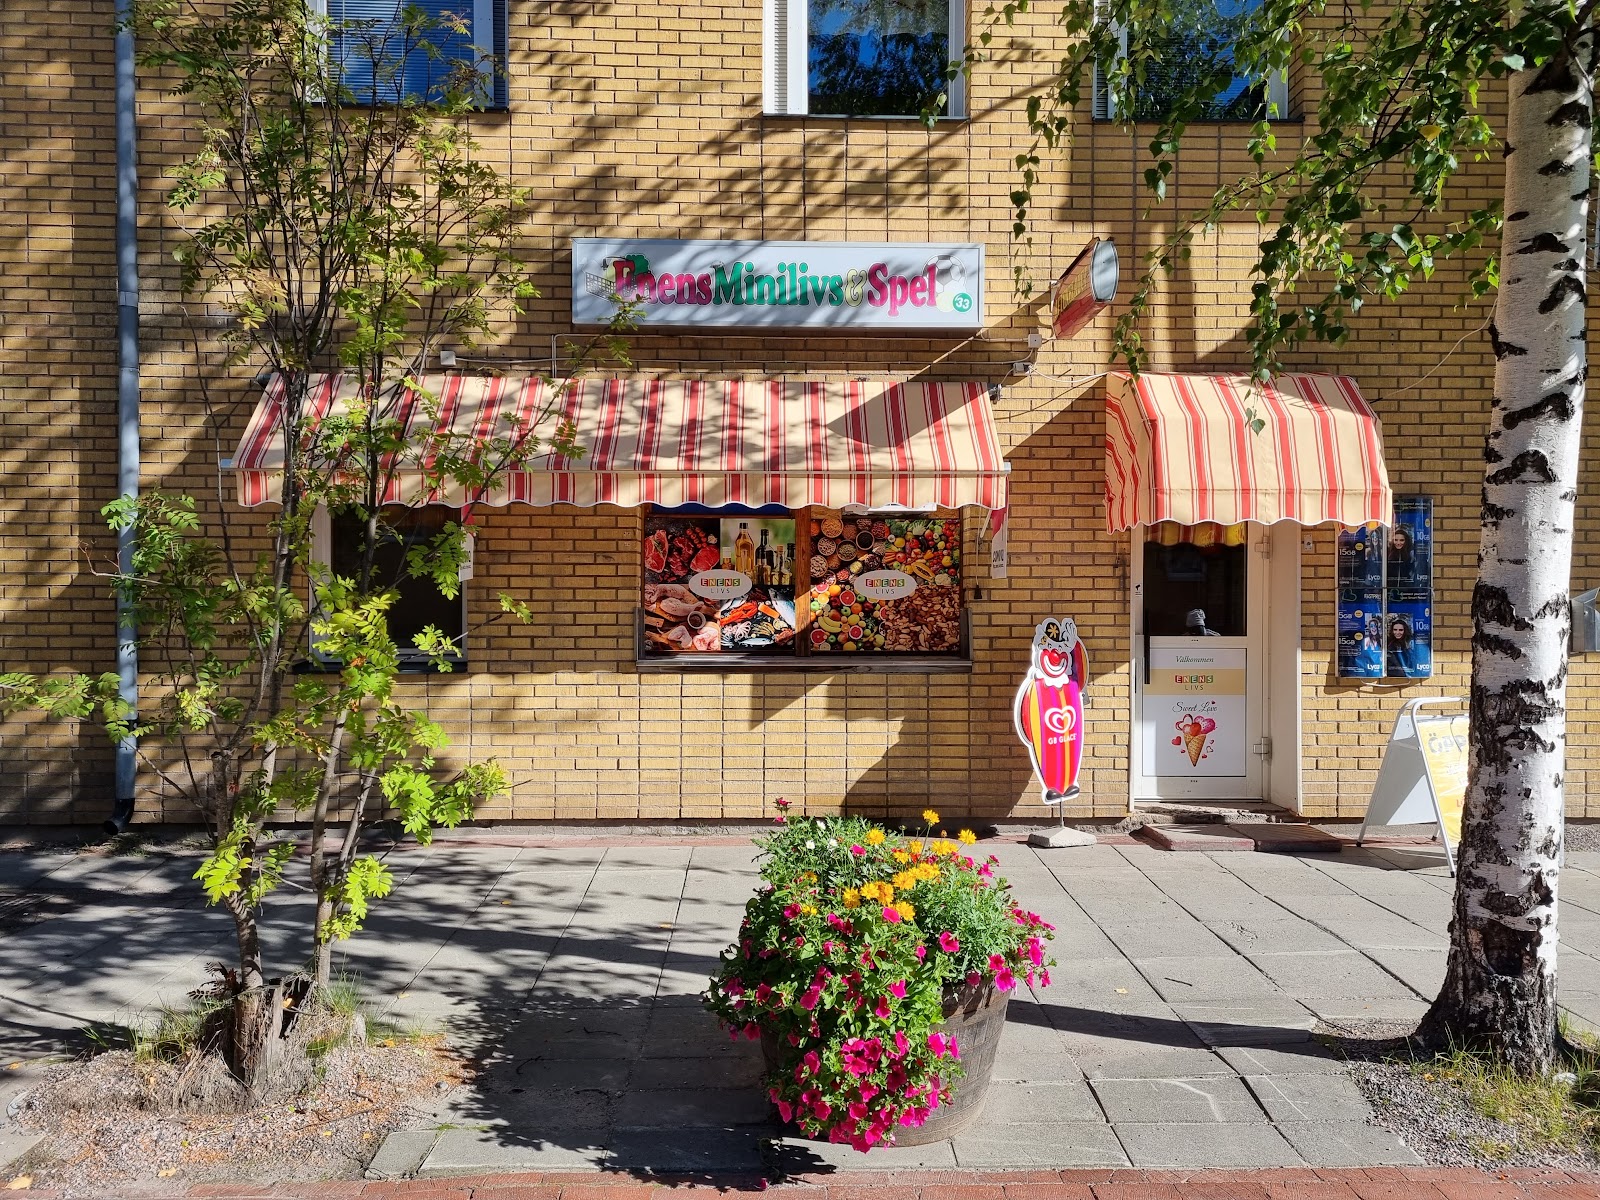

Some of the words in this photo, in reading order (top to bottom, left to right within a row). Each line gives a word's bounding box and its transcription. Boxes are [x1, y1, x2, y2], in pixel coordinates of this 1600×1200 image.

[712, 261, 844, 307] Minilivs
[867, 262, 938, 317] Spel
[954, 296, 970, 310] 33
[701, 578, 740, 587] ENENS
[866, 579, 905, 587] ENENS
[1175, 655, 1214, 663] Välkommen
[1175, 675, 1214, 683] ENENS
[1172, 701, 1198, 713] Sweet
[1199, 701, 1218, 713] Love
[1058, 733, 1077, 743] GLACE
